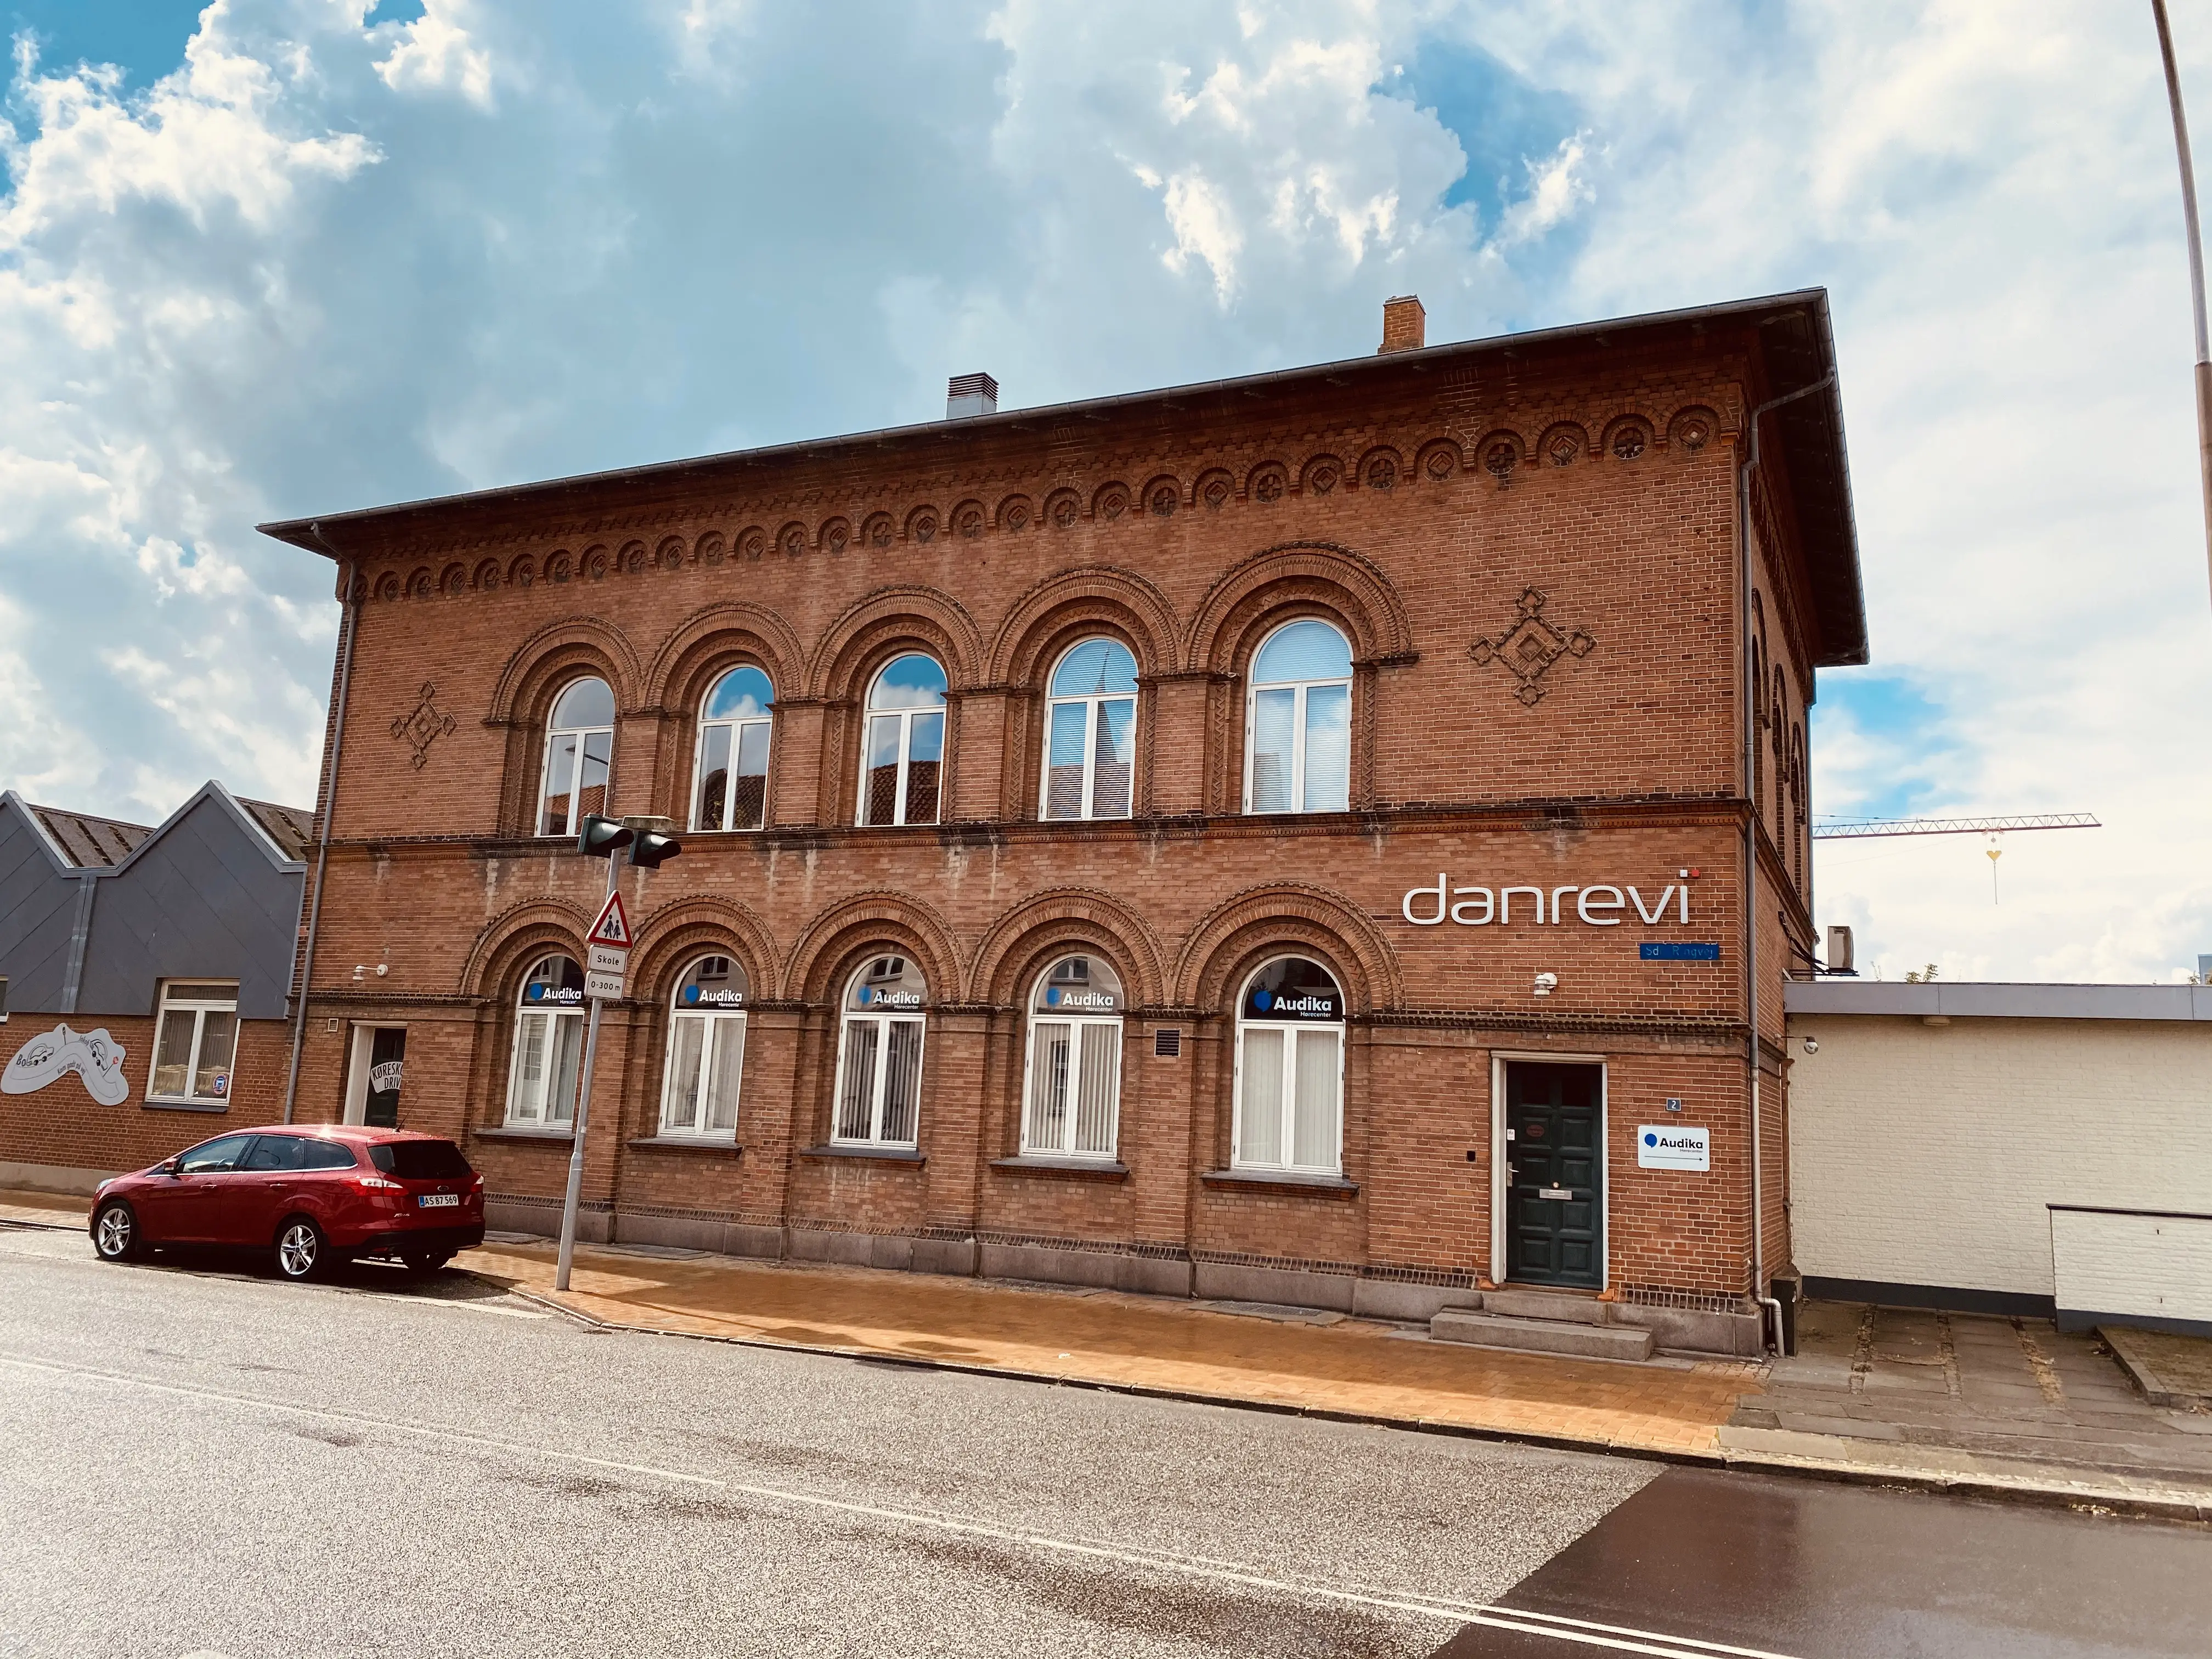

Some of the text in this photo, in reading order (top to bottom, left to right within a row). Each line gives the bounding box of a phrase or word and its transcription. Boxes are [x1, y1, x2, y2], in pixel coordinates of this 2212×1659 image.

[1402, 869, 1689, 925] danrevi
[1672, 945, 1713, 959] Rngvej
[597, 955, 619, 966] Skole
[591, 981, 613, 990] 0-300
[543, 988, 582, 999] Audika
[699, 989, 742, 1002] Audika
[873, 991, 920, 1004] Audika
[1062, 992, 1114, 1006] Audika
[1273, 996, 1332, 1011] Audika
[16, 1054, 26, 1066] Bo
[1671, 1100, 1677, 1109] 2
[1660, 1137, 1703, 1149] Audika
[435, 1197, 443, 1205] 87
[445, 1196, 457, 1204] 569
